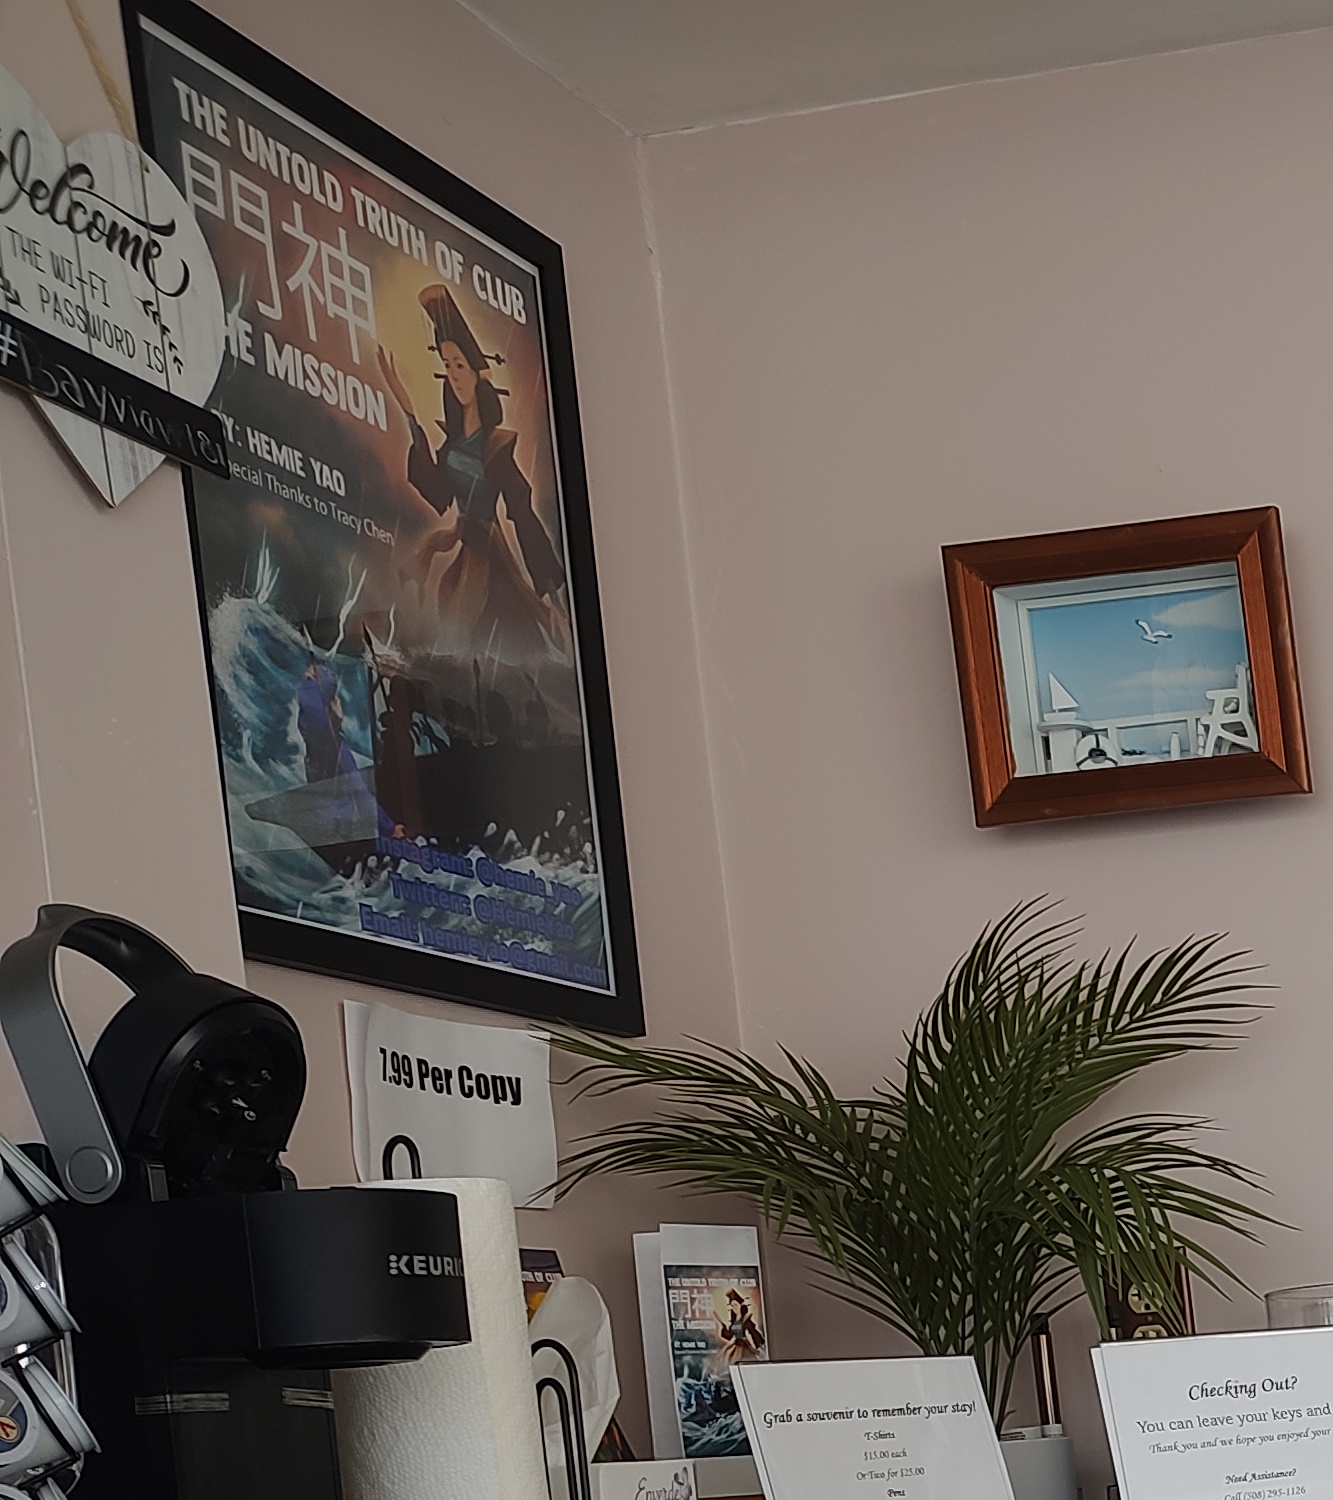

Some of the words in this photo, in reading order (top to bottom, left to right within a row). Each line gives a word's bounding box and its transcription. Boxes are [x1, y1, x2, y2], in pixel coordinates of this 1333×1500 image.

[172, 76, 231, 147] THE
[237, 117, 344, 213] UNTOLD
[351, 186, 429, 267] TRUTH
[434, 240, 466, 285] OF
[472, 264, 527, 325] CLUB
[5, 226, 46, 274] THE
[50, 249, 110, 309] WI-FI
[180, 139, 377, 365] 門神
[38, 284, 136, 359] PASSWORD
[143, 340, 164, 374] IS
[223, 311, 256, 366] HE
[264, 331, 388, 432] MISSION
[247, 426, 306, 478] HEMIE
[309, 456, 346, 497] YAO
[229, 459, 263, 488] ecial
[265, 472, 312, 509] Thanks
[314, 497, 328, 515] to
[329, 502, 362, 534] Tracy
[363, 519, 395, 546] Chen
[377, 835, 474, 879] Instagram:
[359, 902, 420, 943] Email:
[416, 1058, 453, 1095] Per
[458, 1065, 522, 1106] Copy
[1188, 1380, 1256, 1401] Checking
[1261, 1376, 1298, 1393] Out?
[763, 1408, 793, 1428] Grab
[796, 1413, 804, 1422] a
[806, 1406, 853, 1422] souvenir
[857, 1407, 869, 1419] to
[872, 1402, 922, 1418] remember
[923, 1404, 949, 1419] your
[951, 1400, 977, 1417] stay!
[1136, 1420, 1165, 1434] You
[1168, 1417, 1194, 1431] can
[1197, 1415, 1234, 1428] leave
[1236, 1412, 1268, 1428] your
[1272, 1408, 1303, 1423] keys
[1306, 1402, 1332, 1417] and
[864, 1430, 896, 1441] T-Shirts
[1149, 1442, 1183, 1454] Thank
[1181, 1441, 1198, 1453] you
[1200, 1437, 1218, 1449] and
[1219, 1438, 1234, 1447] we
[1235, 1434, 1257, 1446] hope
[1258, 1434, 1275, 1445] you
[1276, 1427, 1310, 1443] enjoyed
[1311, 1427, 1331, 1440] your
[864, 1450, 889, 1461] $15.00
[891, 1447, 907, 1458] each
[856, 1471, 868, 1481] Or
[869, 1470, 885, 1480] Two
[886, 1469, 898, 1481] for
[900, 1467, 925, 1478] $25.00
[1225, 1474, 1249, 1485] Need
[1248, 1468, 1297, 1482] Assistance?
[1267, 1486, 1306, 1498] 295-1126
[887, 1488, 906, 1498] Pens
